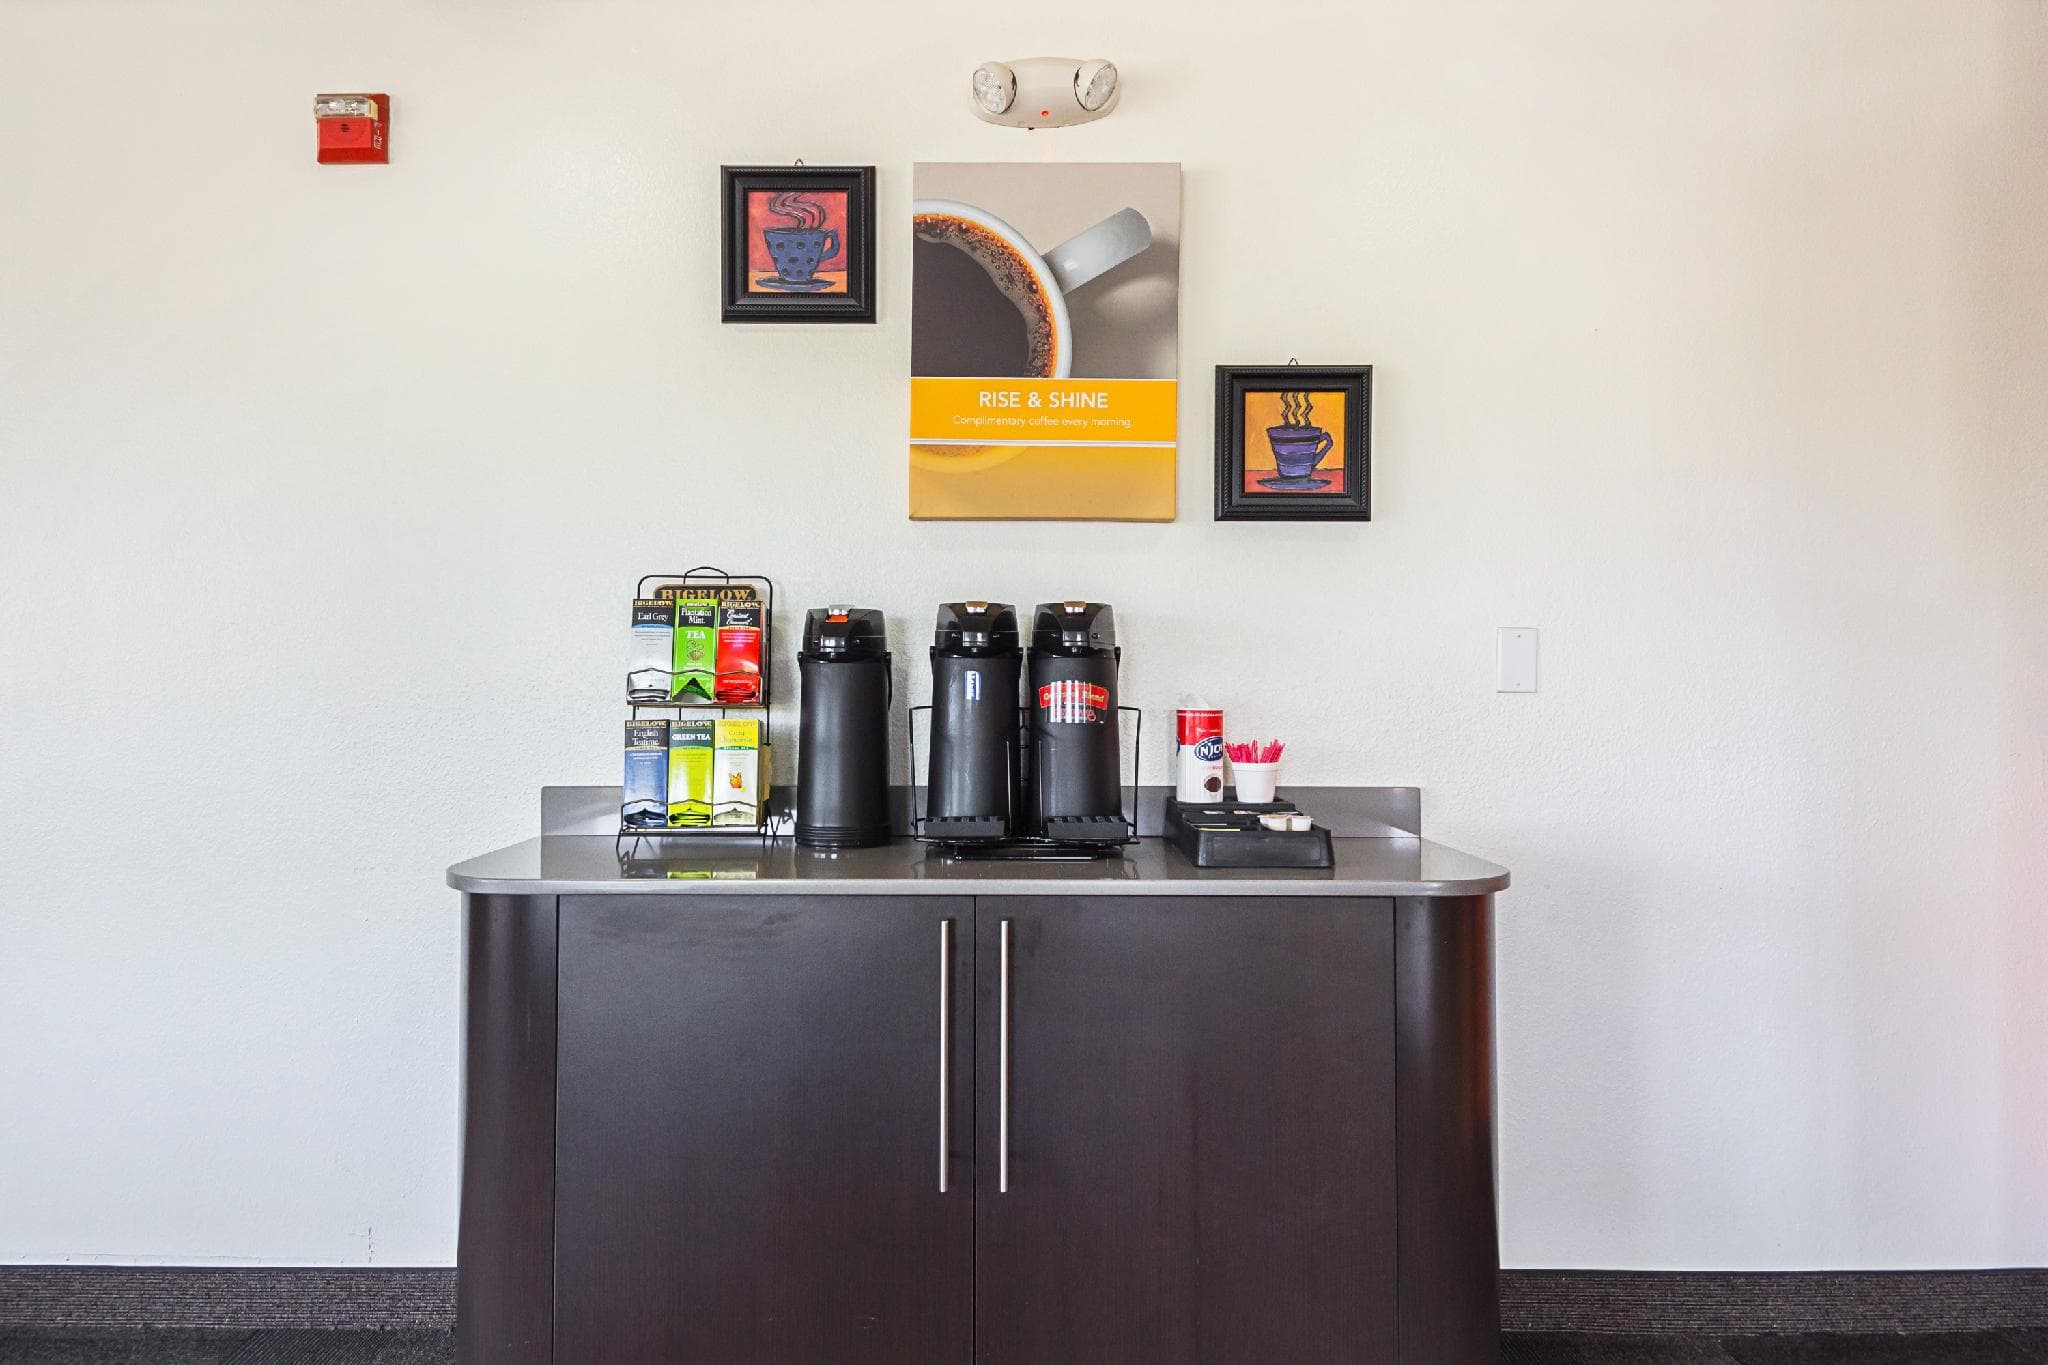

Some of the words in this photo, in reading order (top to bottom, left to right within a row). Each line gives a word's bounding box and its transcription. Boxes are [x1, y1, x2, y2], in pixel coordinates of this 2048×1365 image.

[979, 391, 1021, 408] RISE
[1028, 391, 1042, 408] &
[1048, 391, 1109, 409] SHINE
[952, 415, 1025, 427] Complimentary
[1028, 415, 1059, 426] coffee
[1062, 418, 1088, 428] every
[661, 589, 750, 600] BIGELOW
[637, 612, 652, 620] Earl
[652, 612, 669, 622] Grey
[686, 630, 706, 639] TEA
[671, 733, 696, 741] GREEN
[696, 733, 712, 741] TEA
